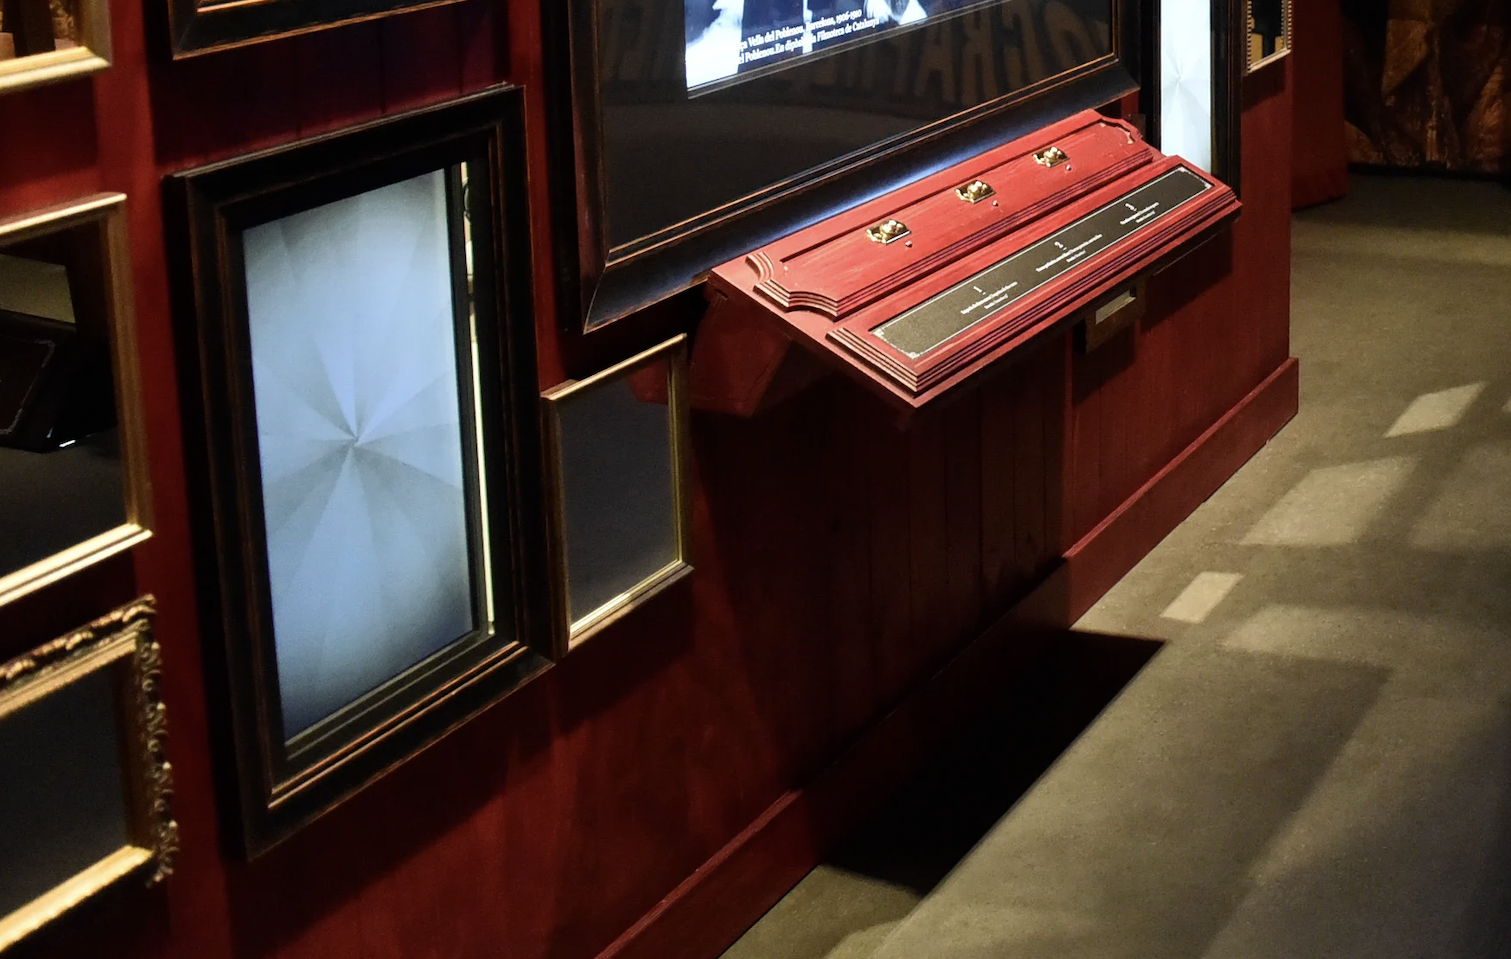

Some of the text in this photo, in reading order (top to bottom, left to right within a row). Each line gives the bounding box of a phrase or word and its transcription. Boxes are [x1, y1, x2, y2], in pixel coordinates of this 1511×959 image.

[747, 35, 765, 48] Vella
[765, 30, 776, 44] del
[805, 16, 836, 33] Barcelona,
[816, 27, 845, 42] Filmoteca
[845, 23, 853, 34] de
[852, 17, 880, 32] Catalunya
